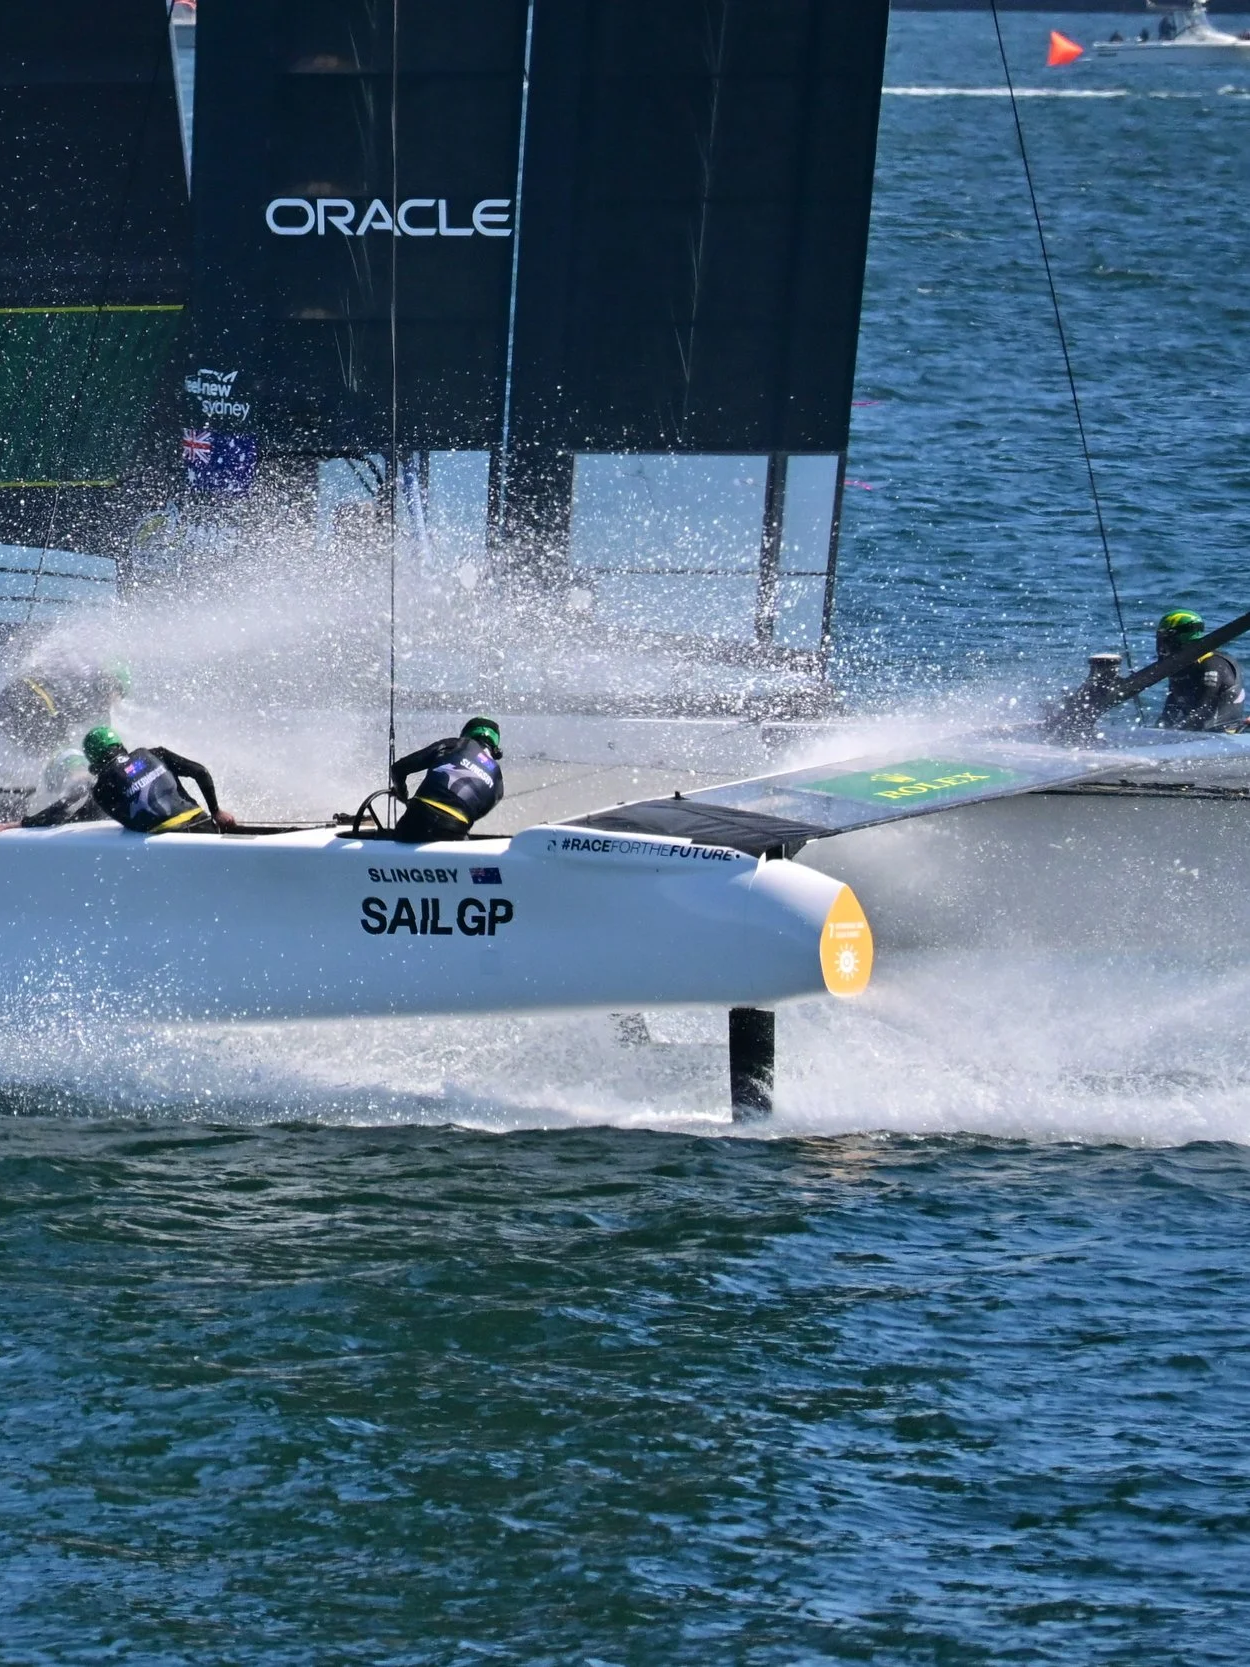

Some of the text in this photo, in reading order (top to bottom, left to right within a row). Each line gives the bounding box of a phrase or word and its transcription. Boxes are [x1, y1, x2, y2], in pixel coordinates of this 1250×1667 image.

[265, 198, 512, 237] ORACLE
[202, 382, 232, 397] new
[201, 398, 250, 421] sydney
[873, 772, 991, 799] ROLEX
[368, 867, 458, 884] SLINGSBY
